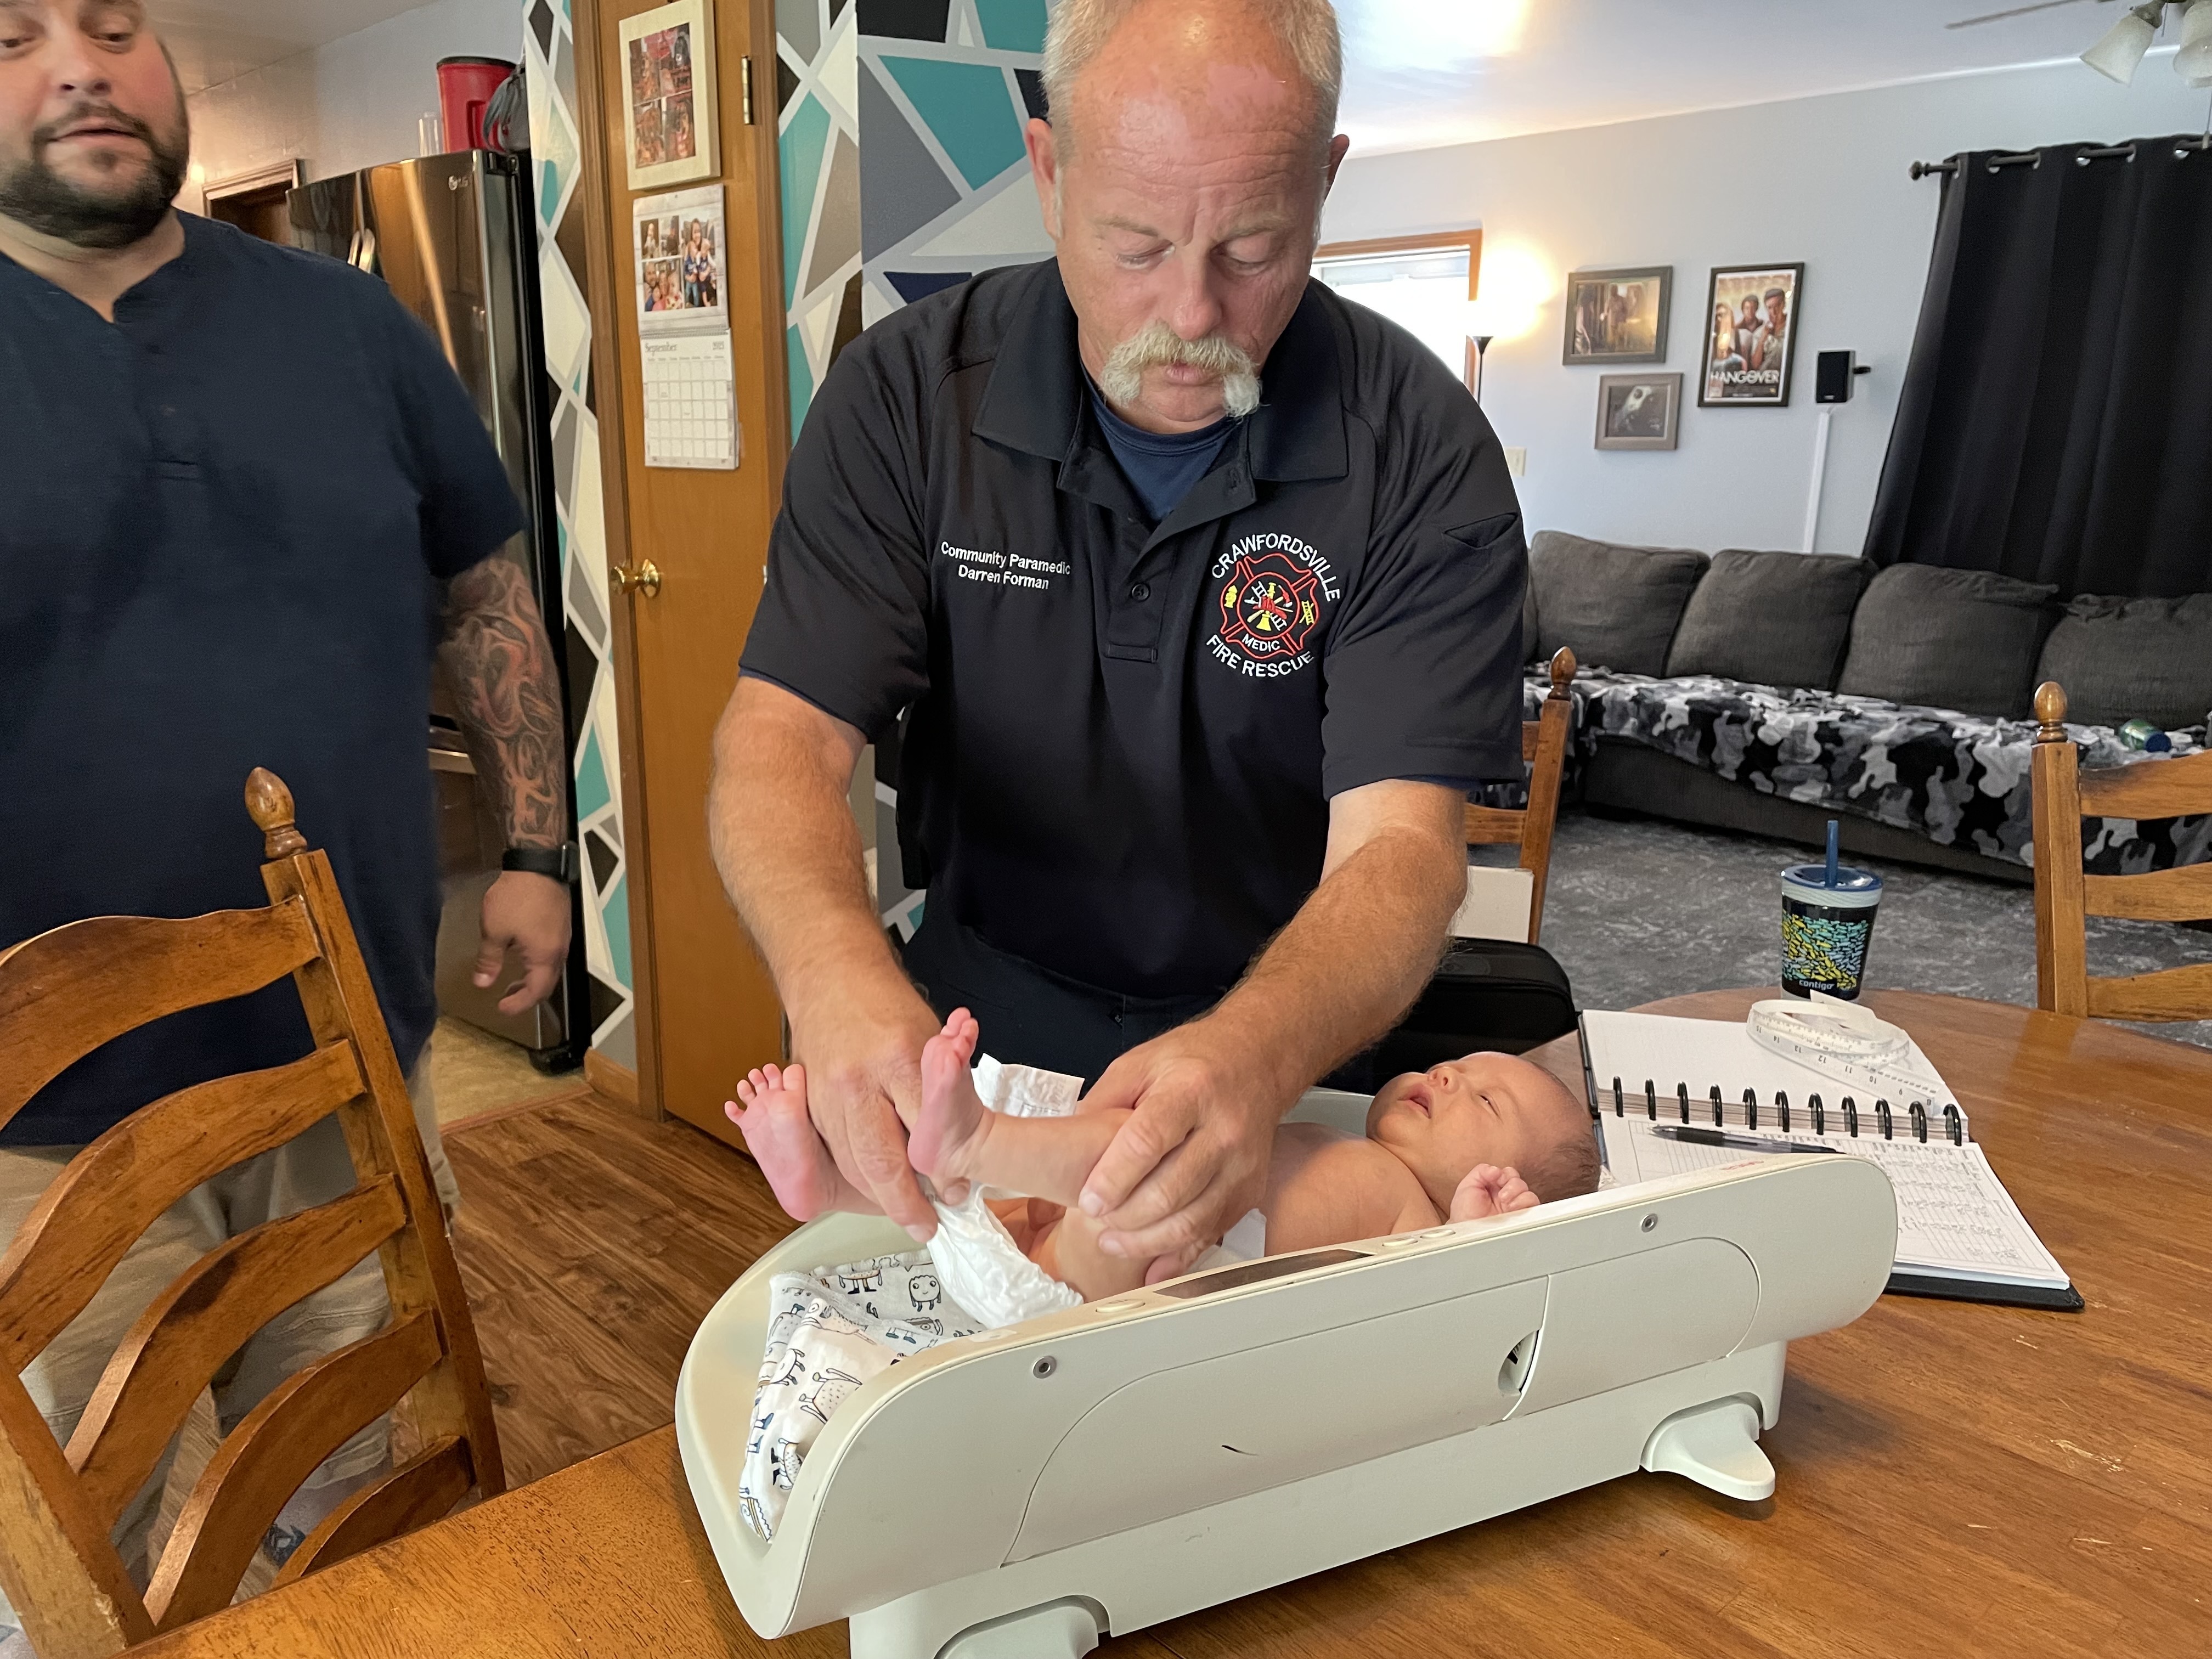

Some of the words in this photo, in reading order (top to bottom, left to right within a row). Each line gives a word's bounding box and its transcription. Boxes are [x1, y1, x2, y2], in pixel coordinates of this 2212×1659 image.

[1710, 369, 1780, 384] HANGOVER
[941, 541, 1007, 568] Community
[1009, 554, 1071, 575] Paramedic
[1211, 532, 1340, 602] CRAWFORDSVILLE
[958, 565, 1001, 583] Darren
[1003, 571, 1049, 590] Forman
[1242, 633, 1280, 652] MEDIC
[1206, 634, 1242, 669] FIRE
[1241, 651, 1314, 678] RESCUE
[1799, 979, 1835, 991] contigo
[1773, 1035, 1780, 1043] 14
[1794, 1045, 1802, 1053] 13
[1818, 1054, 1827, 1064] 12
[1844, 1065, 1852, 1074] 11
[1869, 1075, 1877, 1084] 10
